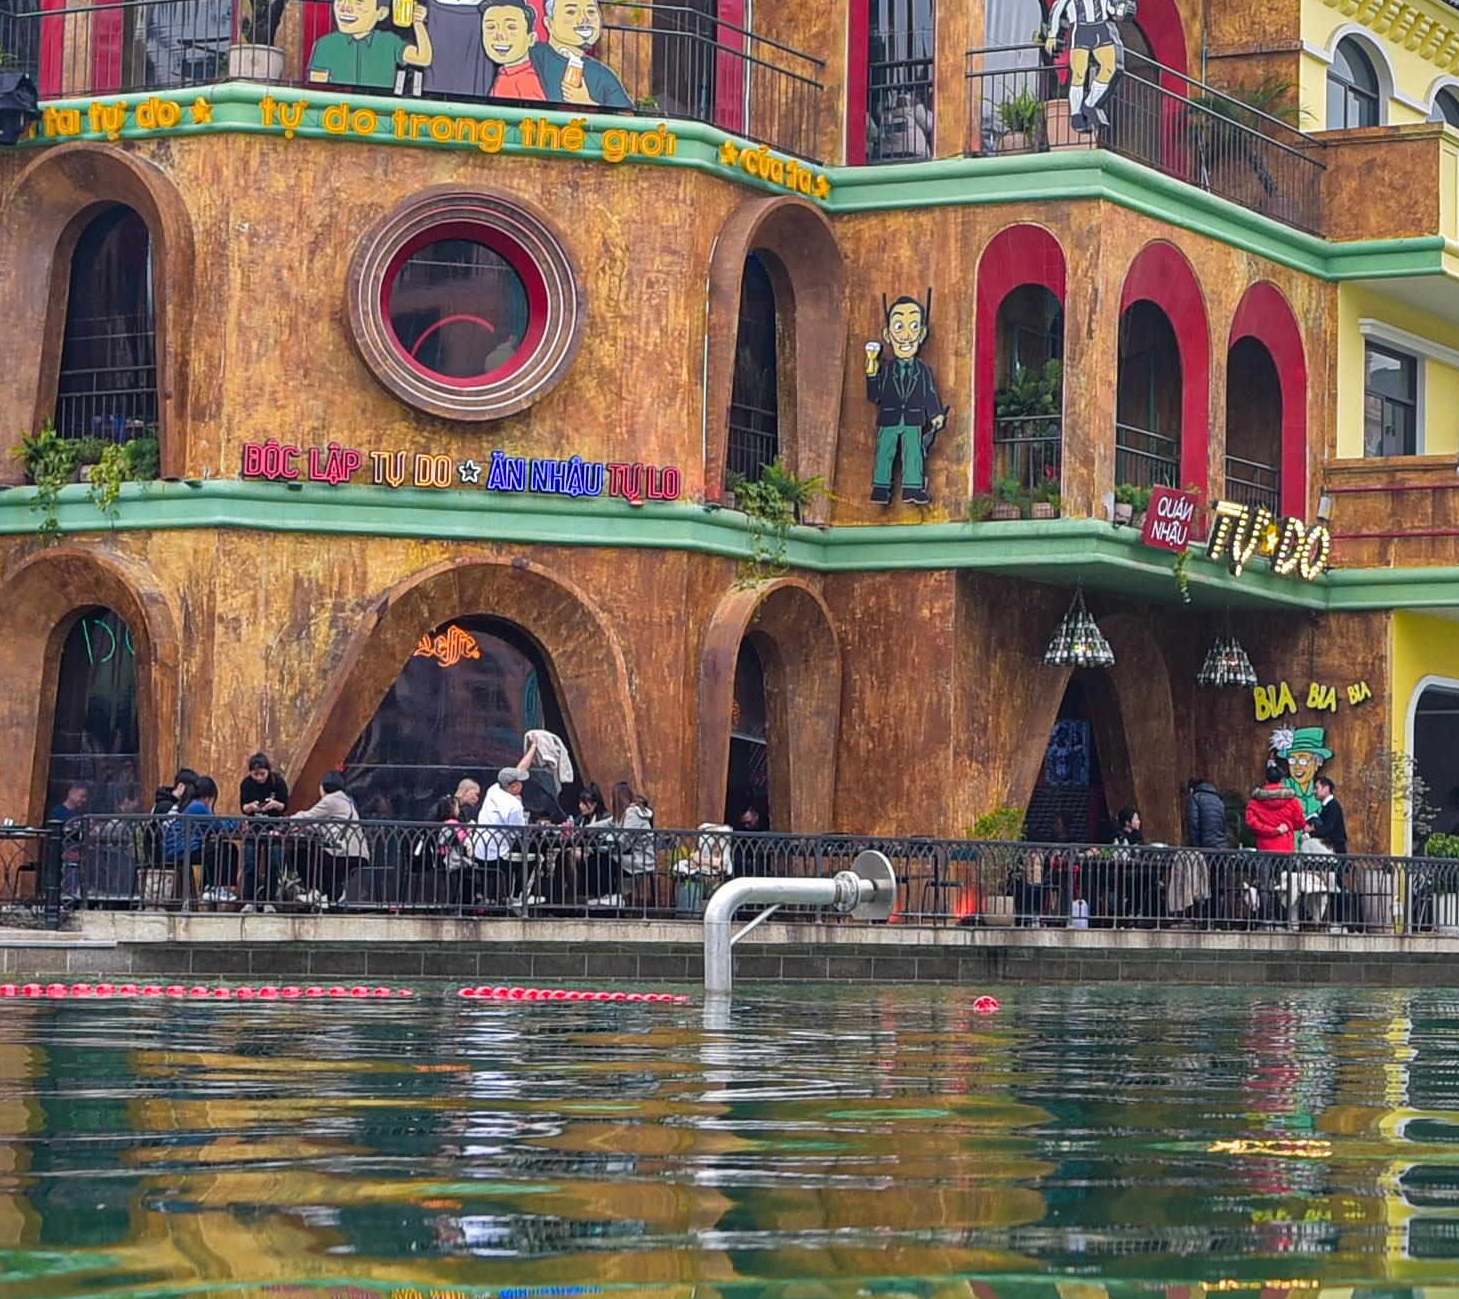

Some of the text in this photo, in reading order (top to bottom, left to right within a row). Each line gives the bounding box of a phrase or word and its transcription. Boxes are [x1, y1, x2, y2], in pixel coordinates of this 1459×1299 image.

[43, 95, 813, 194] ta tự do tự do trong thế giới của ta
[243, 437, 681, 500] ĐỘC LẬP TỰ DO ĂN NHẬU TỰ LO
[1157, 495, 1194, 523] QUÁN
[1150, 519, 1189, 547] NHẬU
[1270, 516, 1331, 581] DO
[413, 624, 481, 668] Leffe
[1253, 681, 1372, 721] BIA BIA BIA
